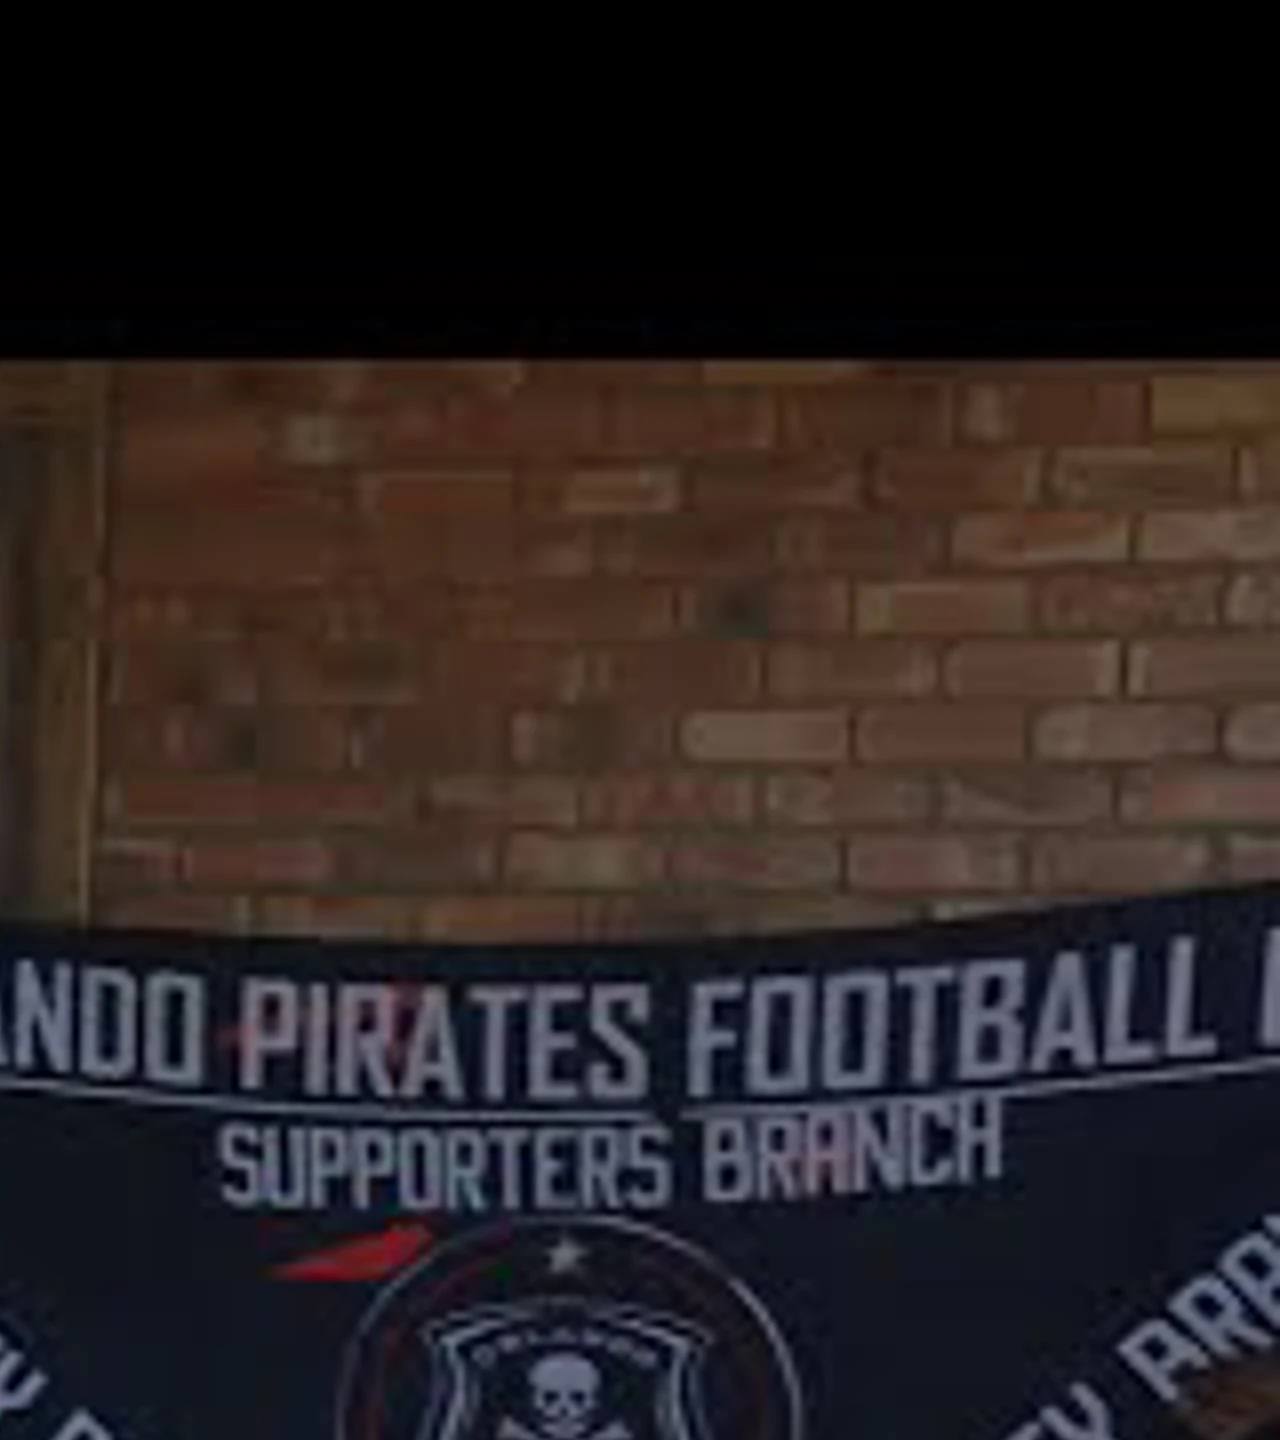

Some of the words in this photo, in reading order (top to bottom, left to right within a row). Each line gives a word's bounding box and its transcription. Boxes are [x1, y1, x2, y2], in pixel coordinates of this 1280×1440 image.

[237, 974, 653, 1102] PIRATES
[686, 933, 1220, 1100] FOOTBALL
[218, 1118, 674, 1212] SUPPORTERS
[700, 1096, 1005, 1204] BRANCH
